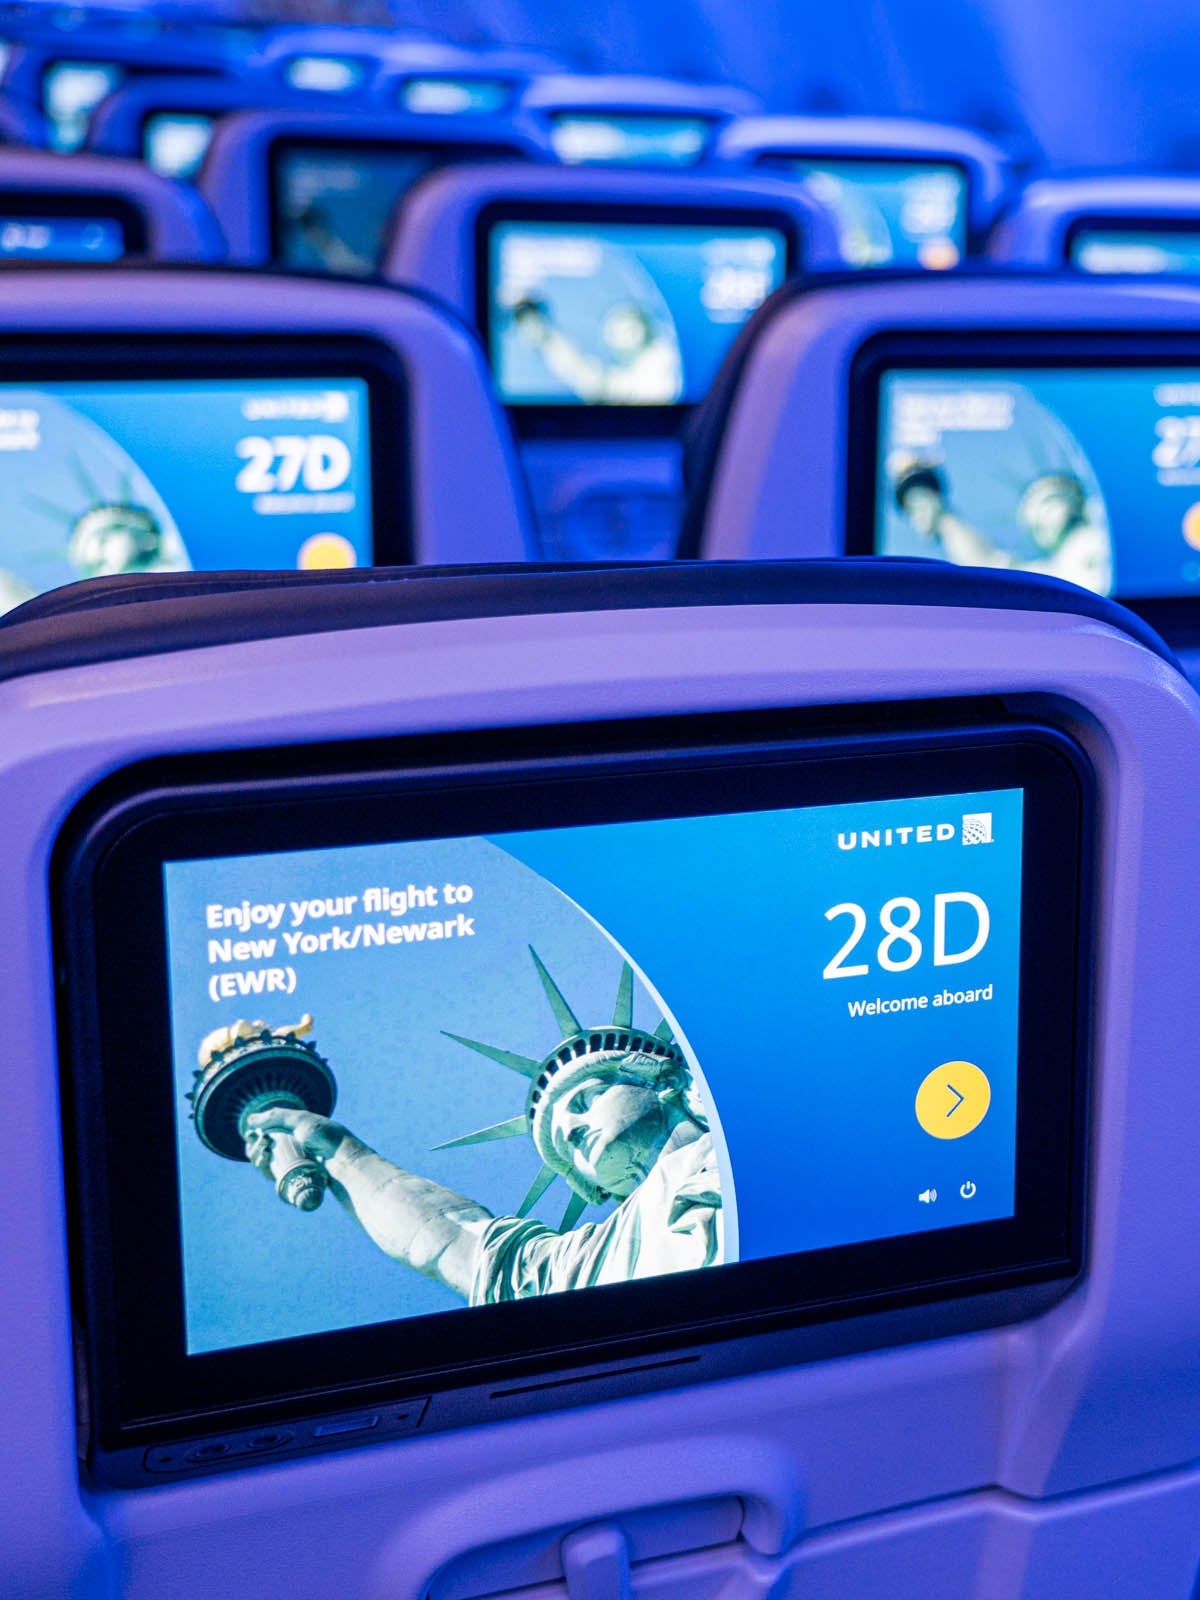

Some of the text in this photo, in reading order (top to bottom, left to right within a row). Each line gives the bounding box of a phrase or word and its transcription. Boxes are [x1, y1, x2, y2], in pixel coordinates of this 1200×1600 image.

[236, 435, 351, 493] 27D
[837, 823, 955, 851] UNITED
[206, 883, 474, 932] Enjoy your flight to
[207, 913, 475, 964] New York/Newark
[822, 891, 990, 980] 28D
[208, 966, 297, 1002] (EWR)
[847, 983, 993, 1018] Welcome aboard
